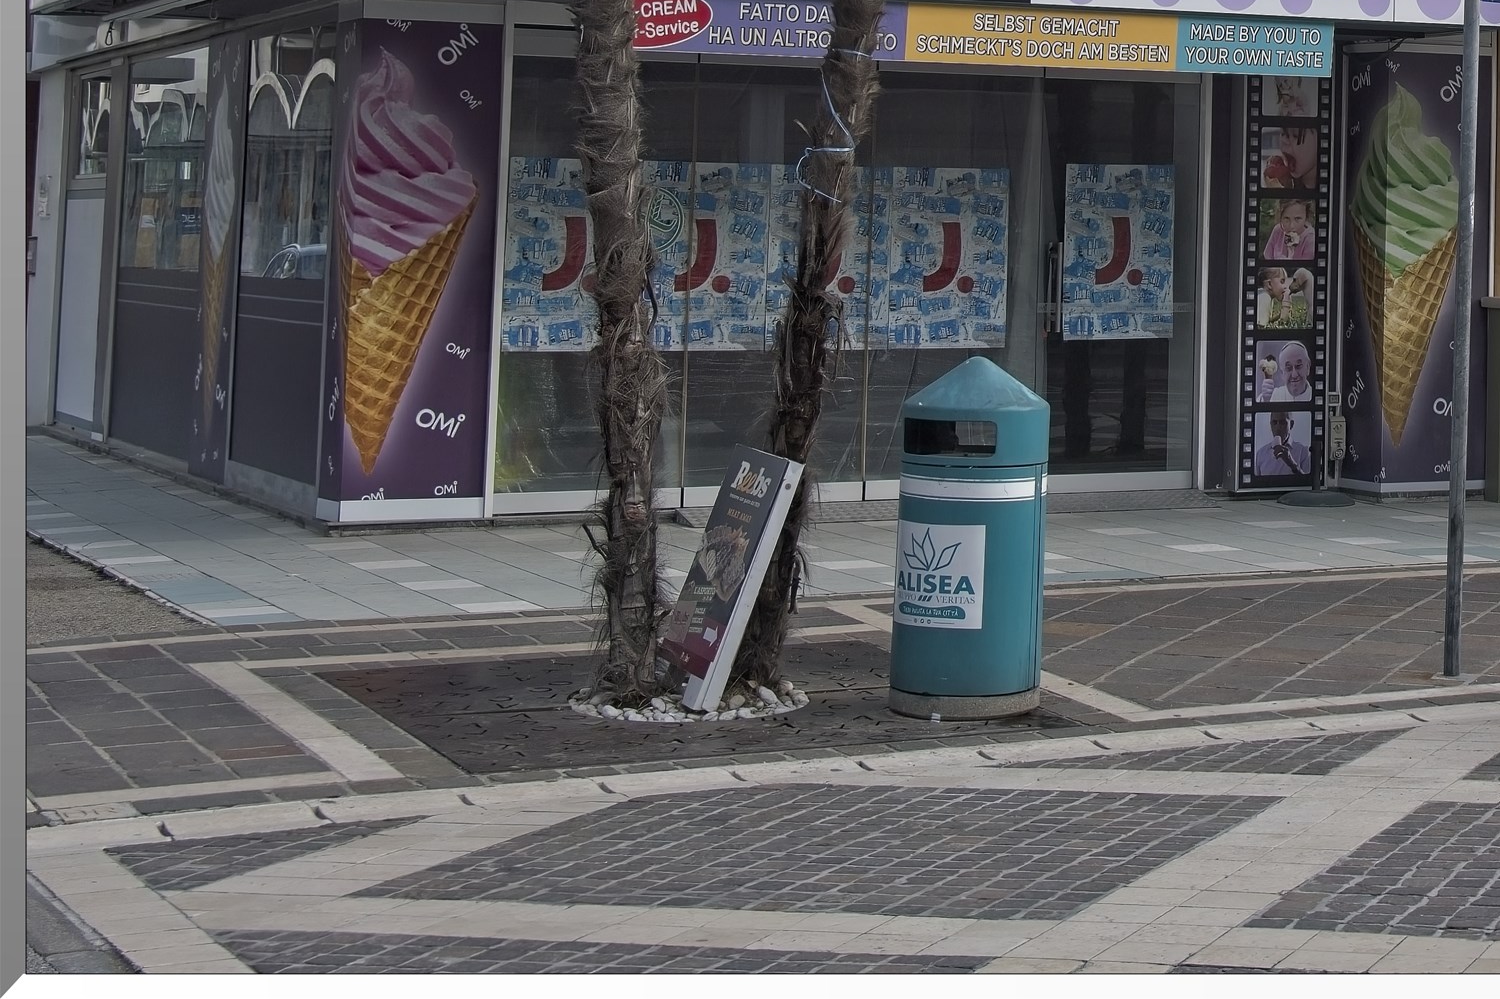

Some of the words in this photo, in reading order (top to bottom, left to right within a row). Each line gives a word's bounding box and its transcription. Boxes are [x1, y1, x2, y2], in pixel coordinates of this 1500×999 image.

[739, 2, 800, 22] FATTO
[805, 5, 831, 23] DA
[973, 12, 1036, 34] SELBST
[1039, 16, 1120, 37] GEMACHT
[1189, 23, 1235, 42] MADE
[1239, 26, 1260, 43] BY
[1264, 27, 1296, 45] YOU
[1300, 28, 1321, 45] TO
[708, 25, 735, 45] HA
[740, 27, 767, 46] UN
[771, 28, 832, 49] ALTRO
[1026, 40, 1074, 58] DOCH
[1078, 42, 1104, 60] AM
[1108, 43, 1170, 63] BESTEN
[1185, 46, 1229, 65] YOUR
[1233, 48, 1272, 66] OWN
[1276, 50, 1323, 68] TASTE
[415, 408, 466, 438] OMi
[897, 570, 976, 595] ALISEA
[936, 595, 976, 605] VERITAS
